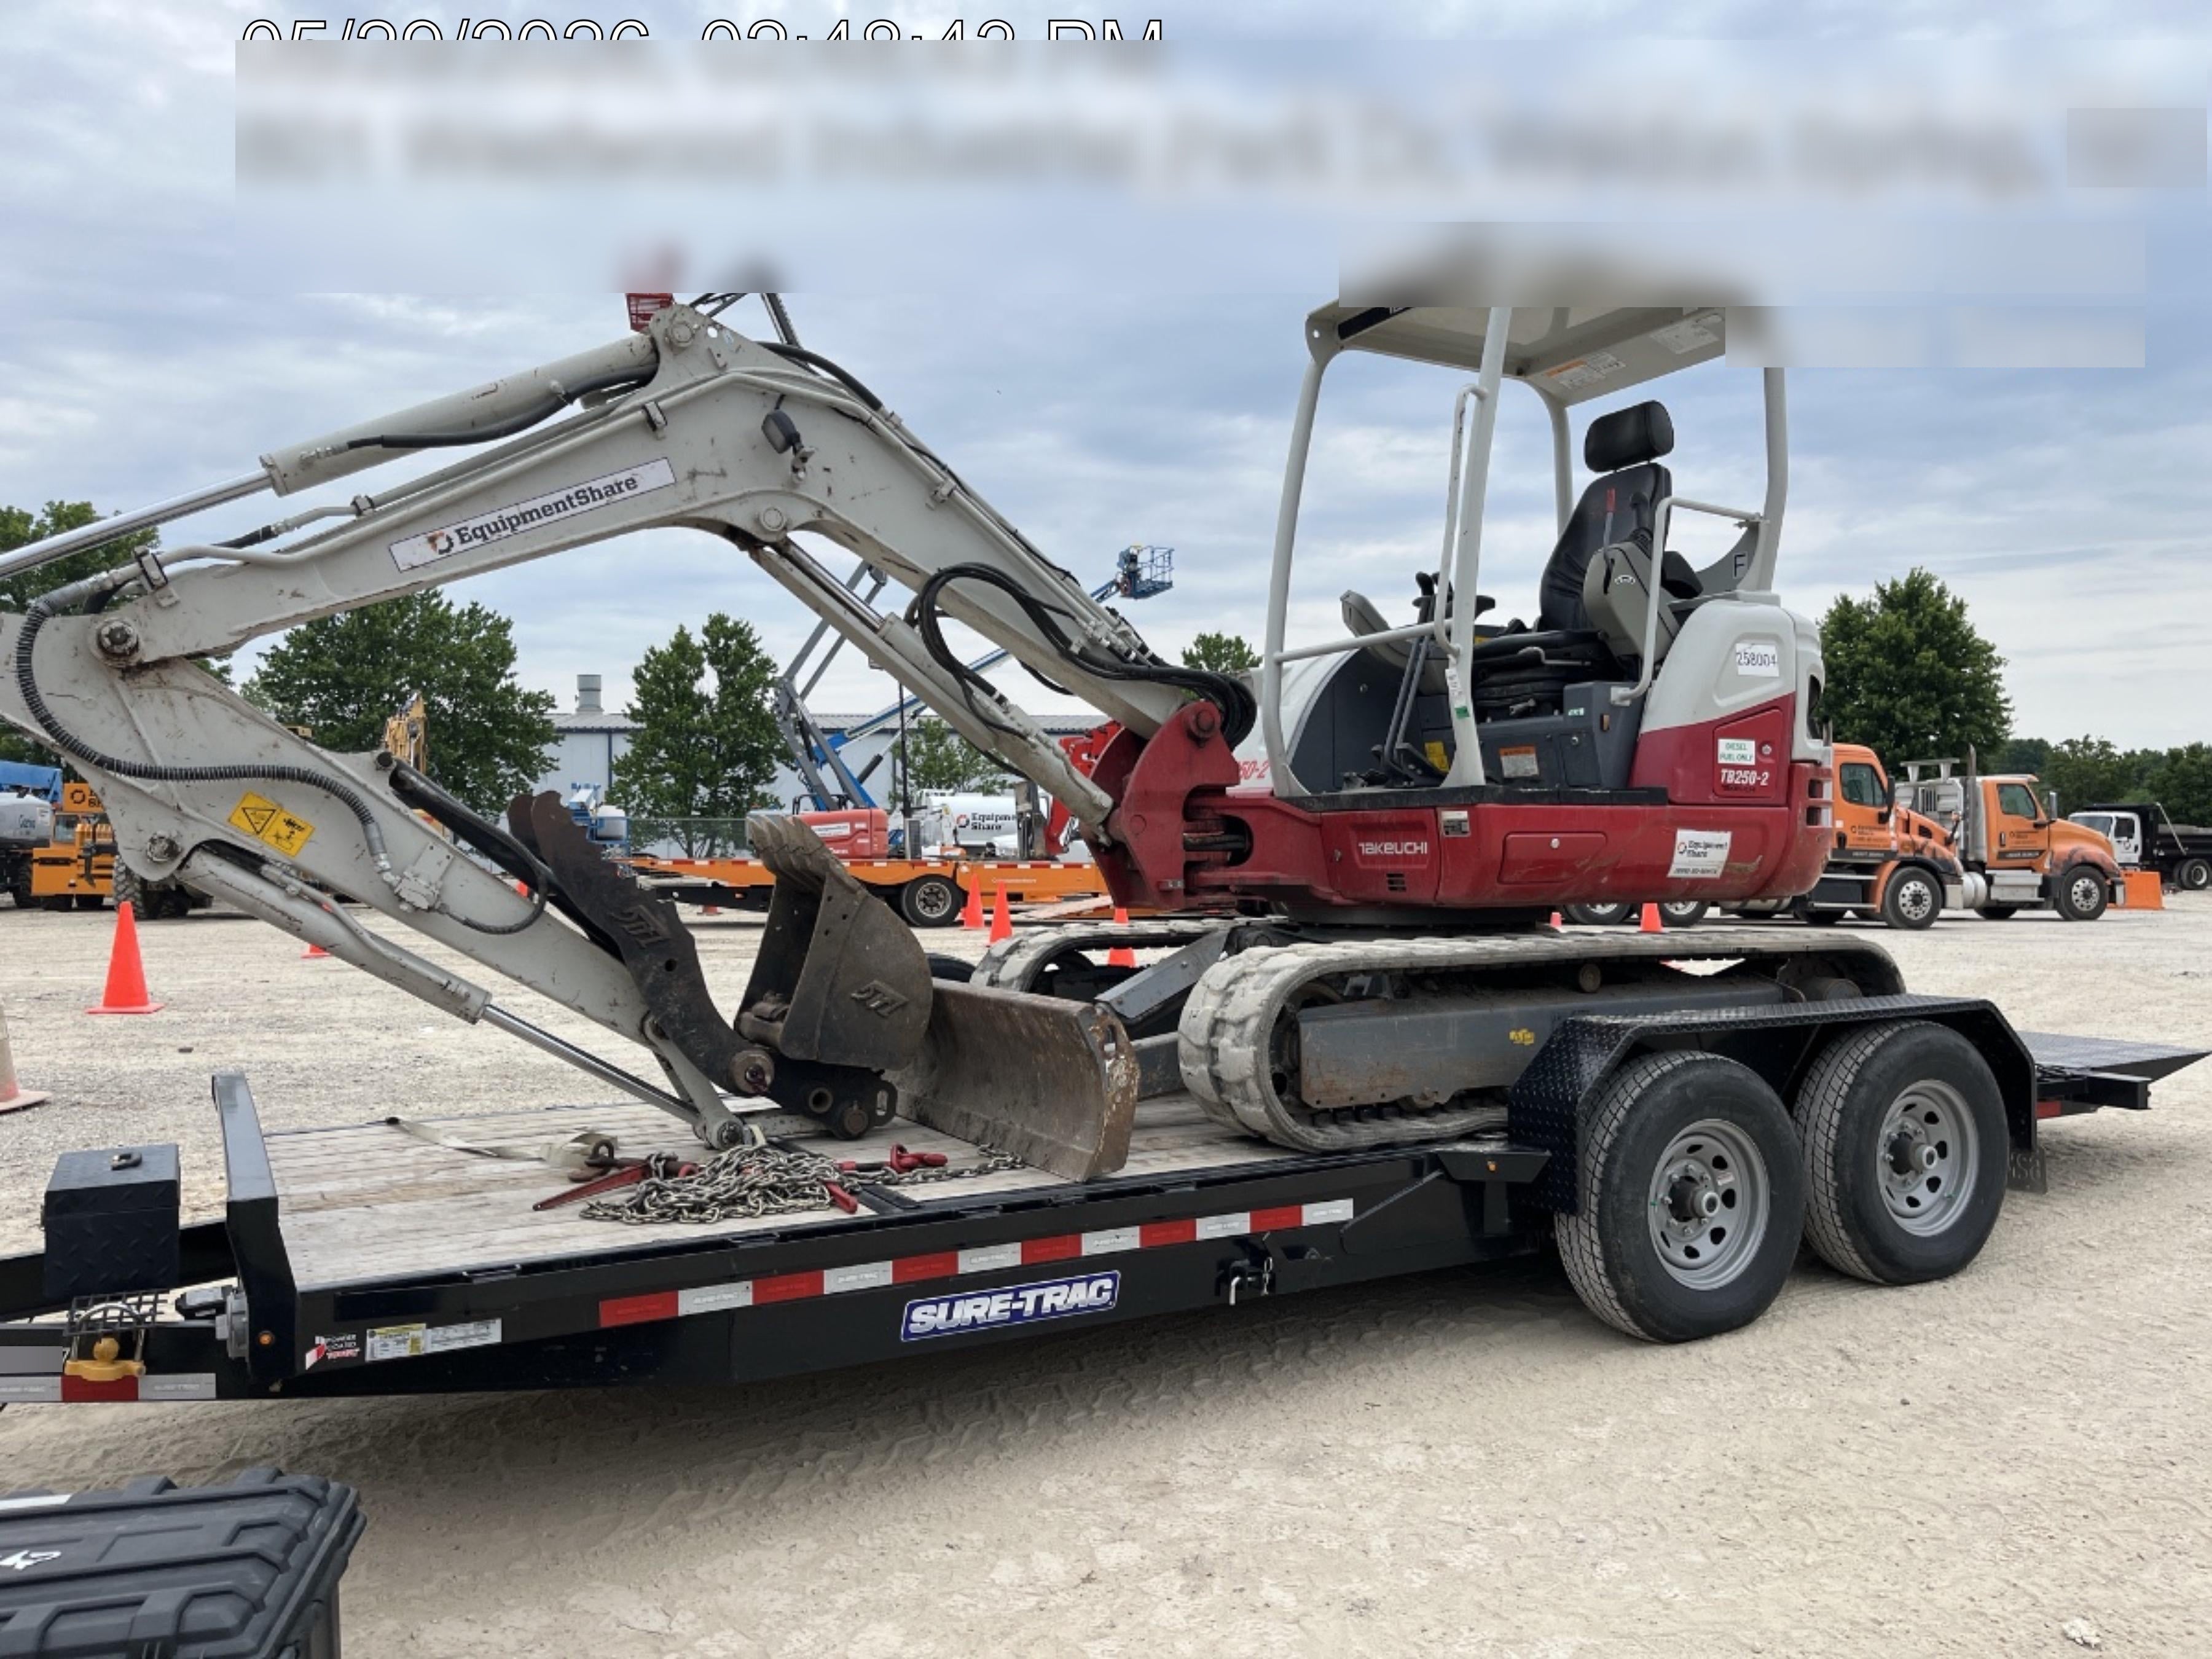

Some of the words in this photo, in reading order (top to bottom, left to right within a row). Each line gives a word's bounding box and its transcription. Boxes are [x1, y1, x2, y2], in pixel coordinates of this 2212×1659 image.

[455, 476, 638, 546] EquipmentShare
[1721, 768, 1770, 786] TB250-2
[971, 822, 1002, 831] Share
[909, 1279, 1113, 1333] SURE-TRAC
